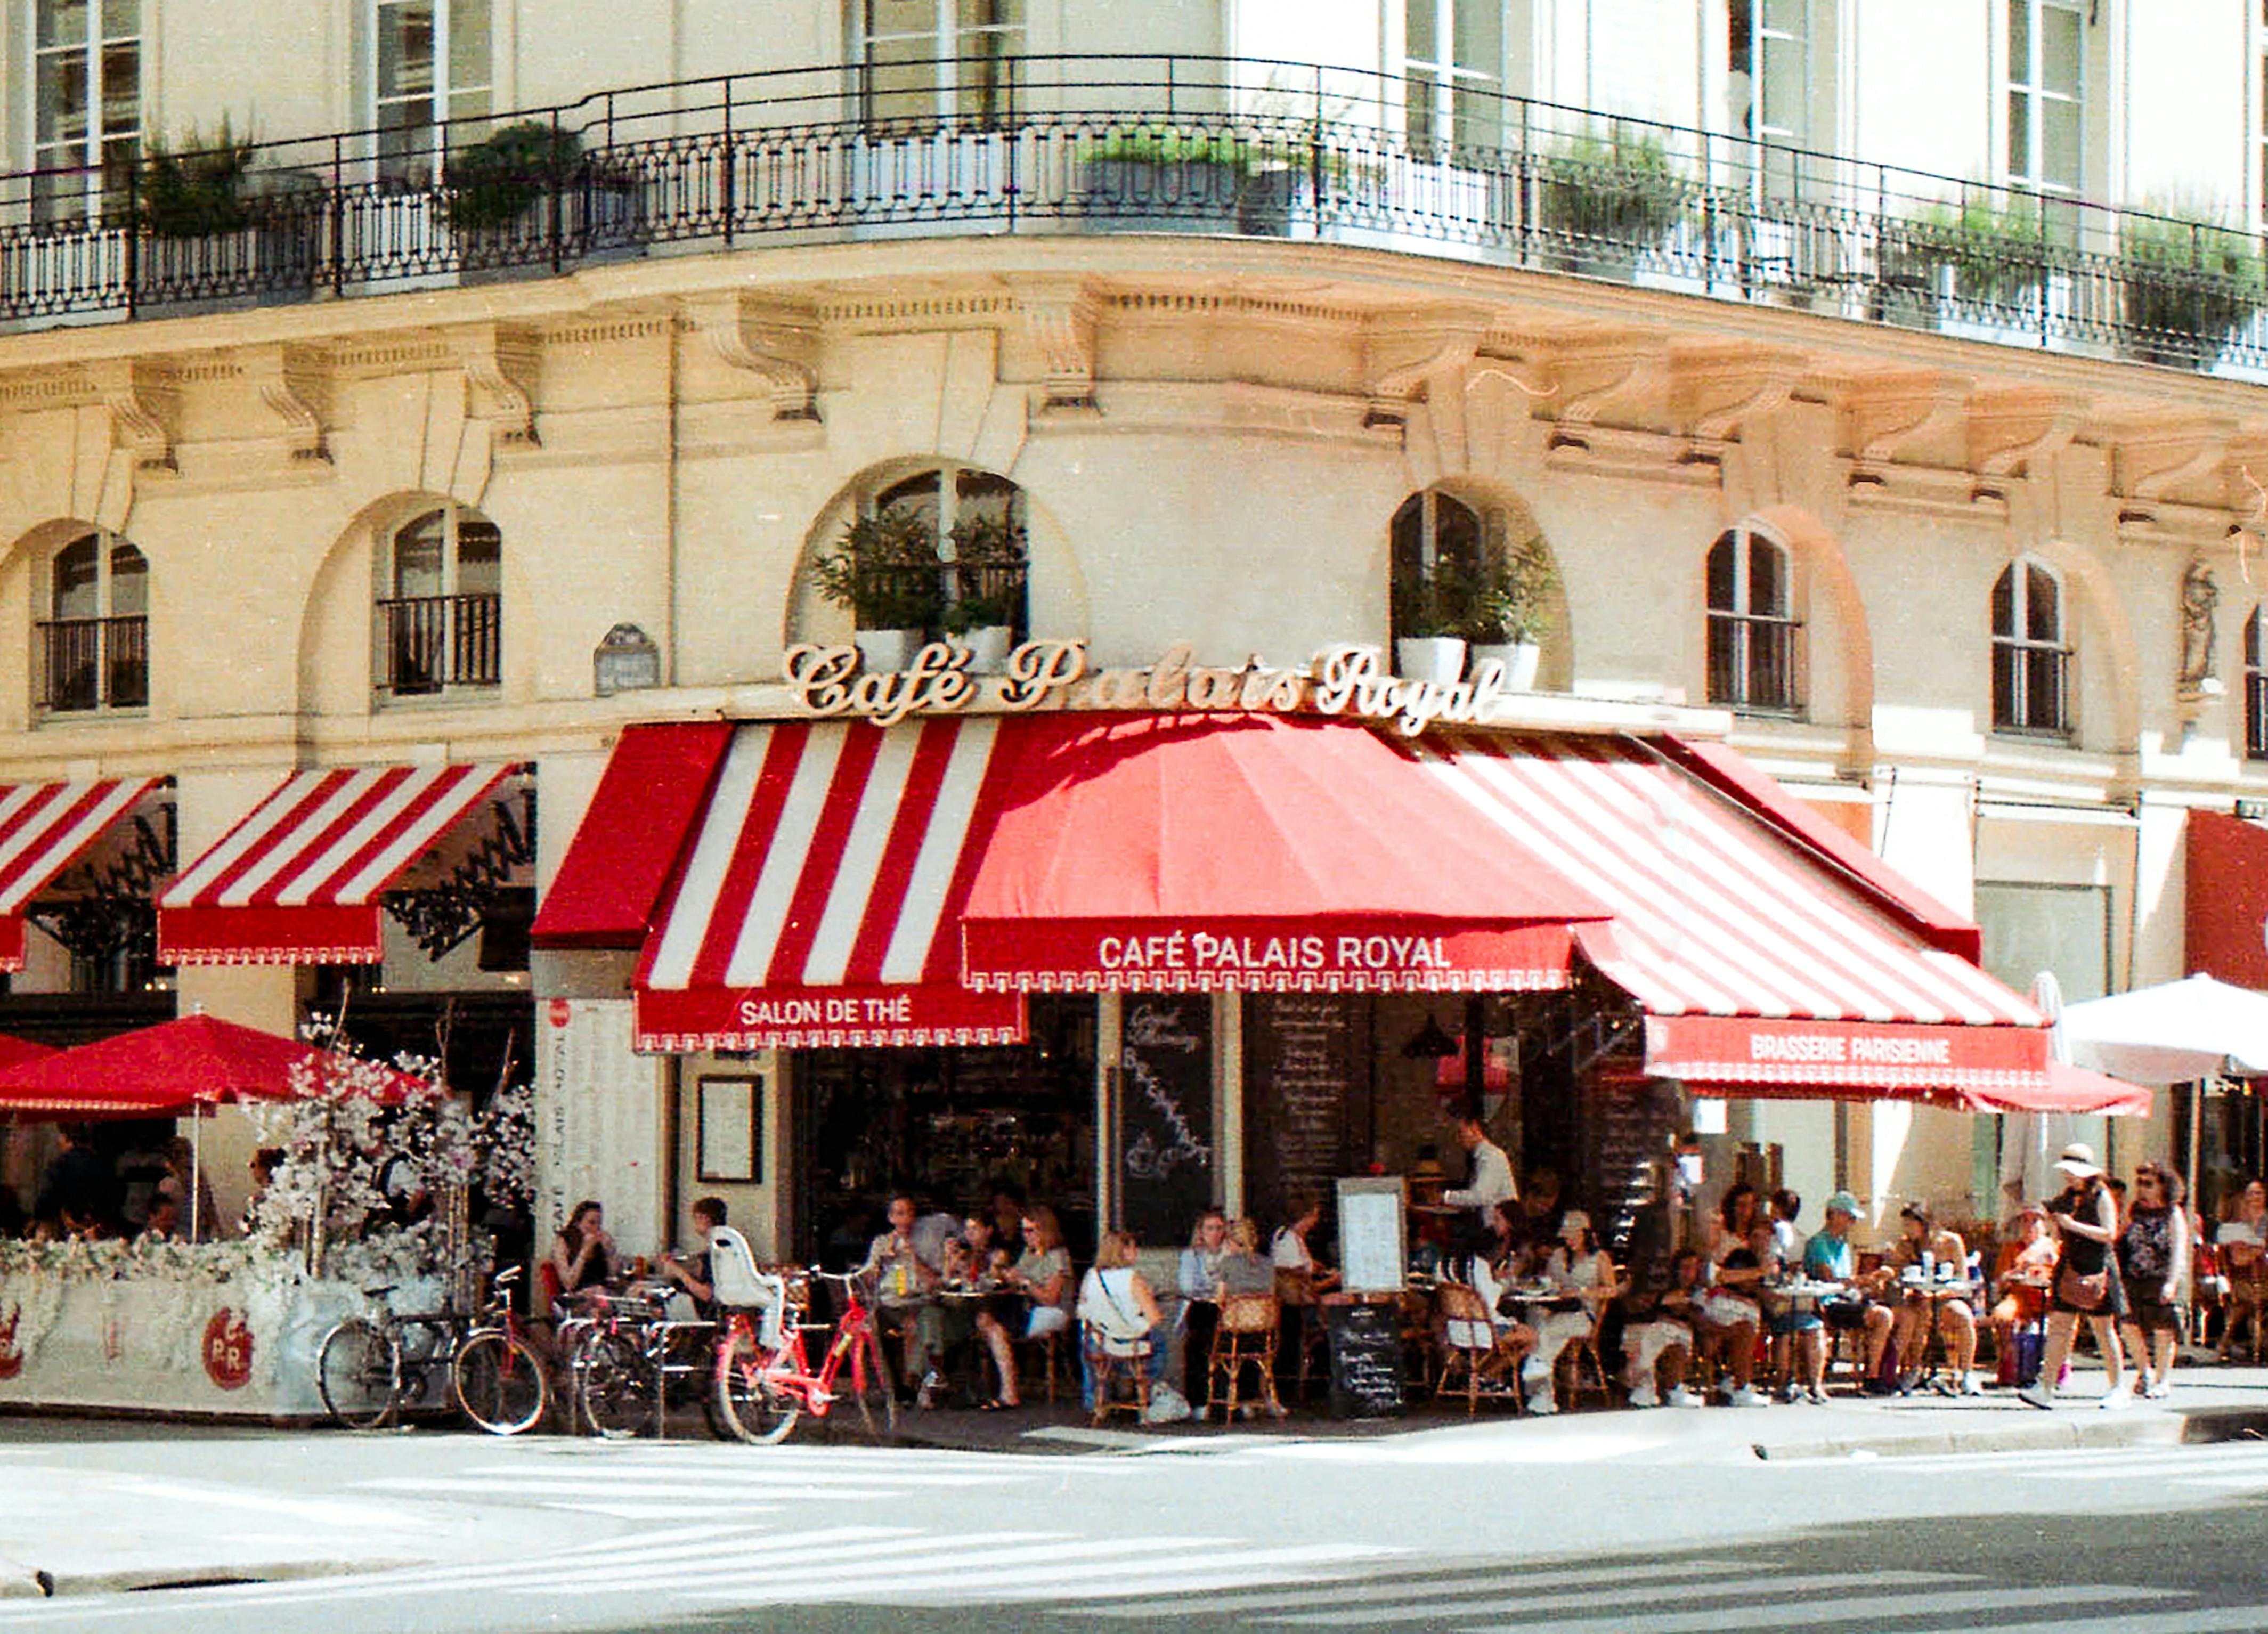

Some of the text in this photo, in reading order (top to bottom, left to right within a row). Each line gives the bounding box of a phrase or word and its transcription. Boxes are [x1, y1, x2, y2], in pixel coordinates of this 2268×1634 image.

[783, 639, 1506, 736] Café Palais Royal
[1099, 930, 1451, 969] CAFÉ PALAIS ROYAL
[741, 993, 912, 1025] SALON DE THÉ
[1750, 1033, 1951, 1064] BRASSERIE PARISIENNE
